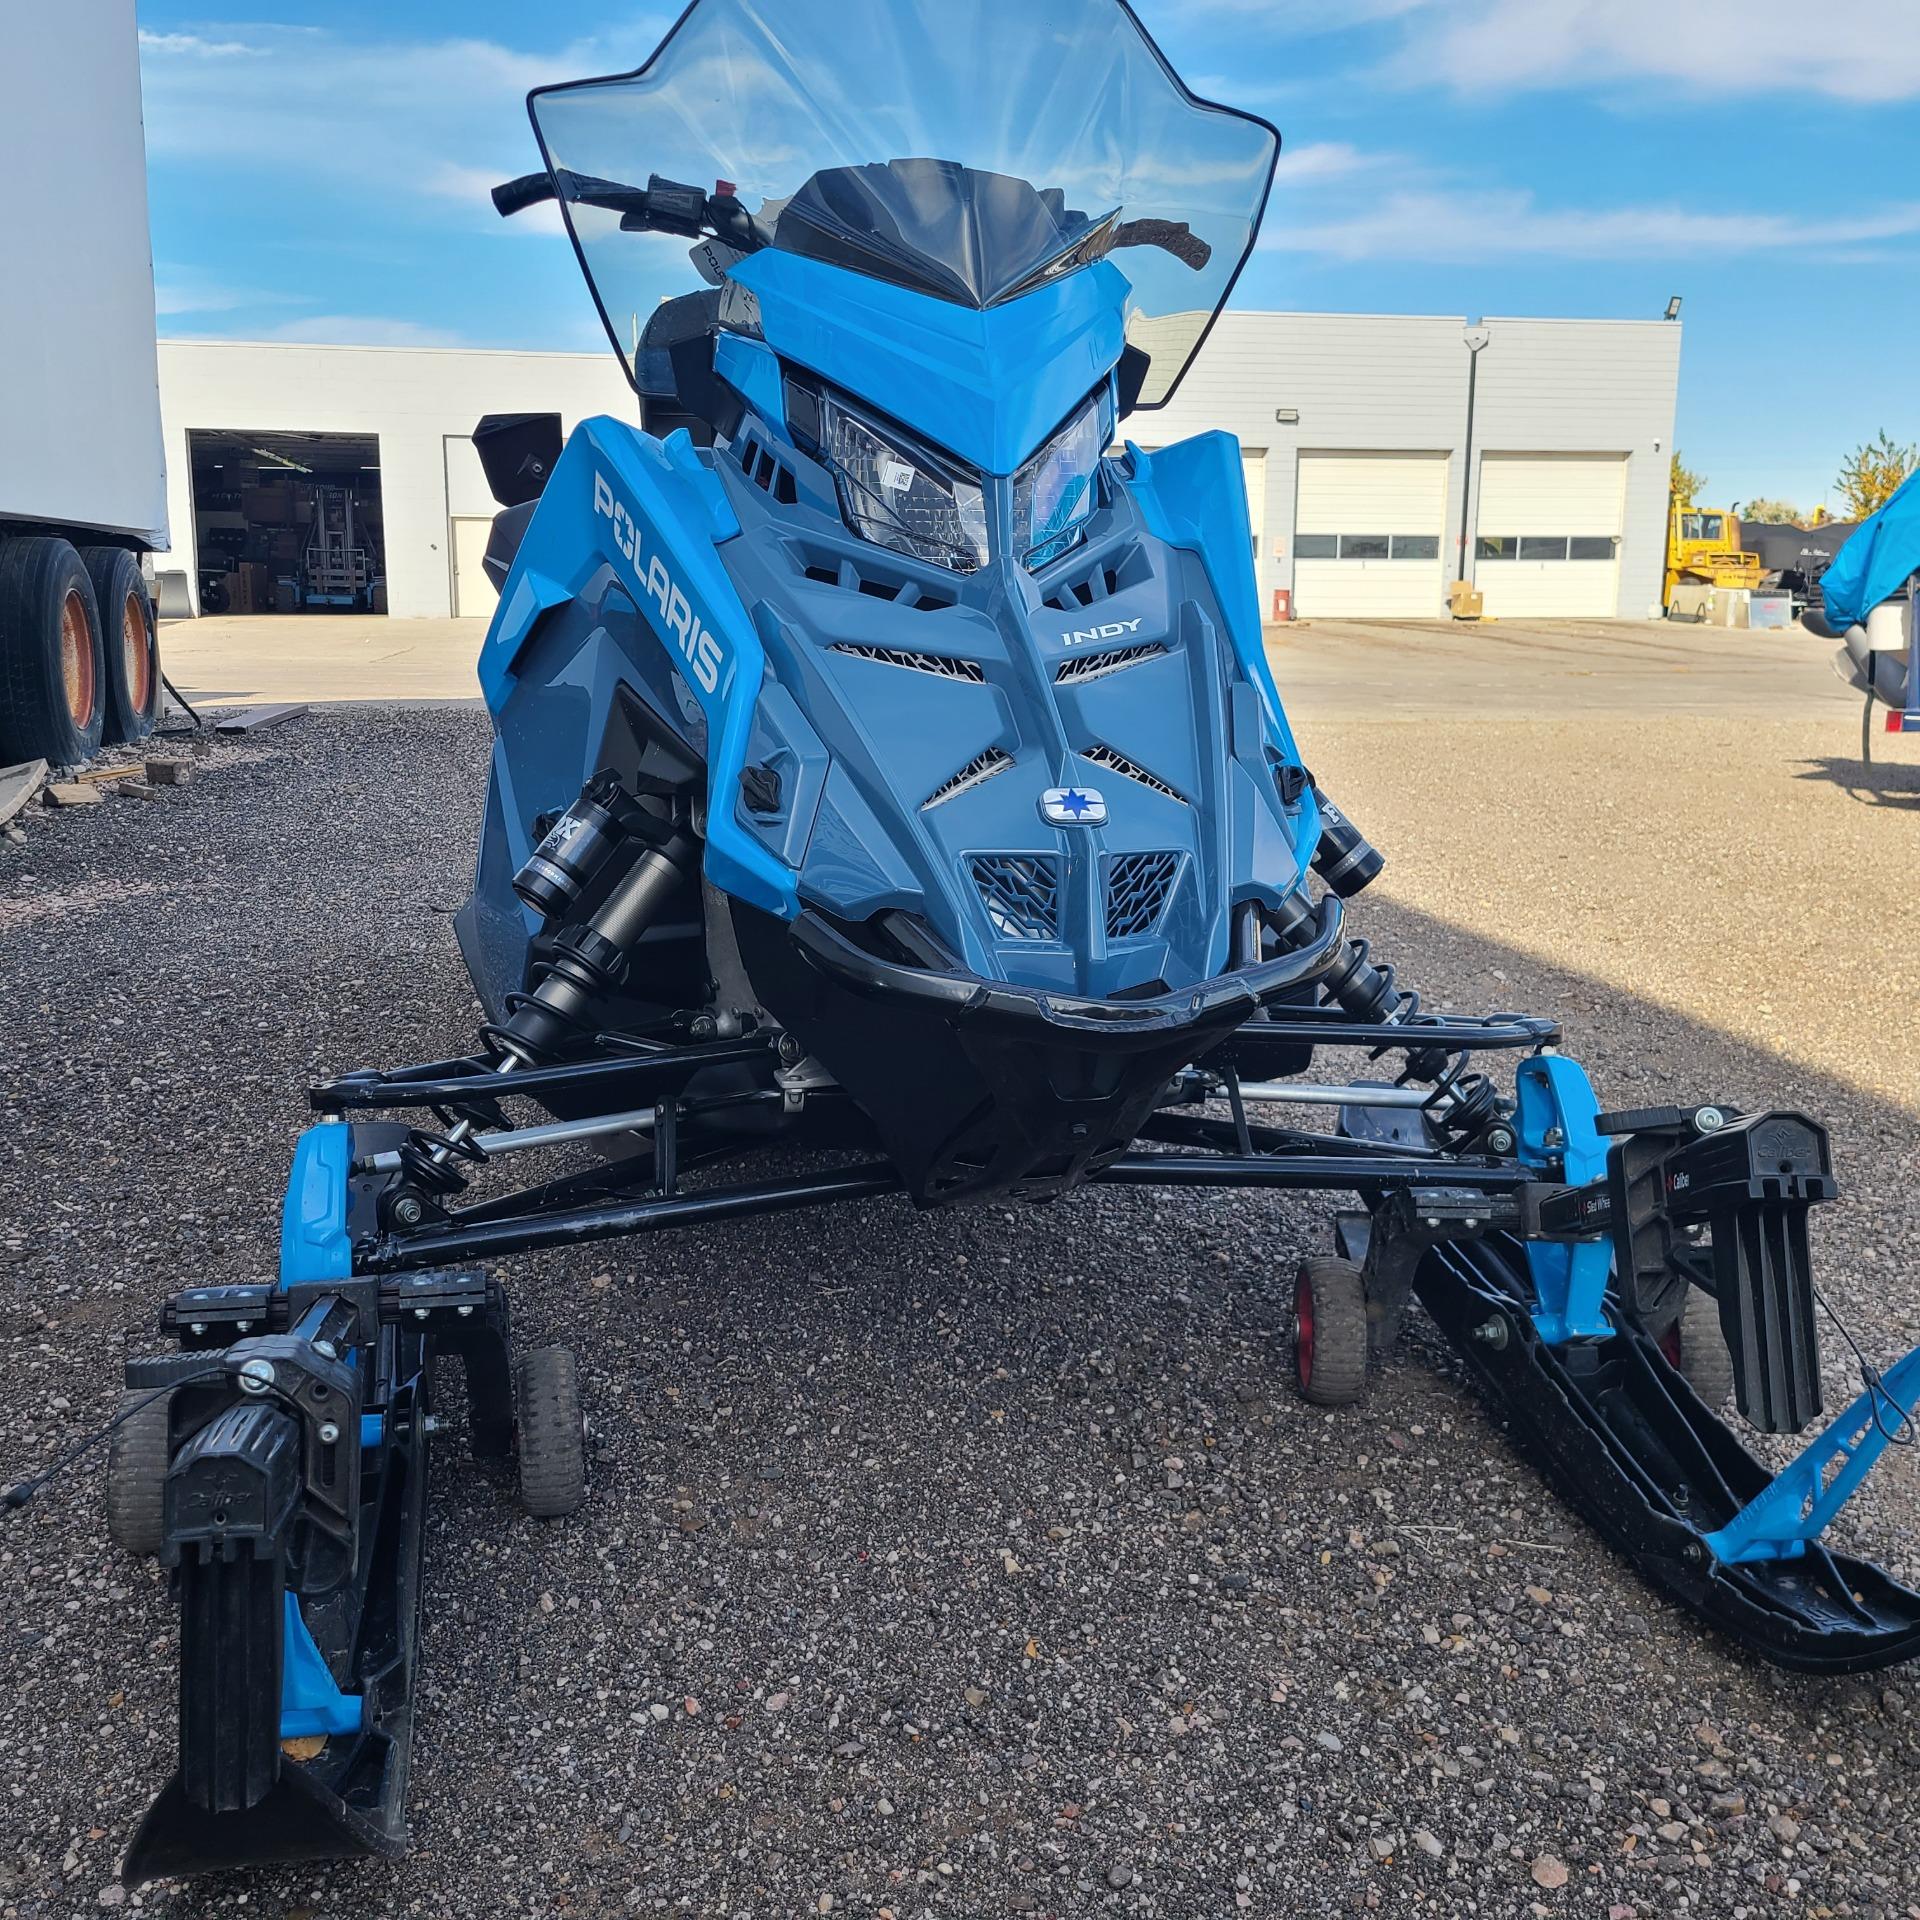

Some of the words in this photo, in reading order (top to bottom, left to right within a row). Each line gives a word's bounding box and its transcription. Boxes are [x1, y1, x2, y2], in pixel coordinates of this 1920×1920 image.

[702, 245, 728, 282] POLA
[594, 470, 723, 693] POLARIS
[1061, 617, 1143, 646] INDY
